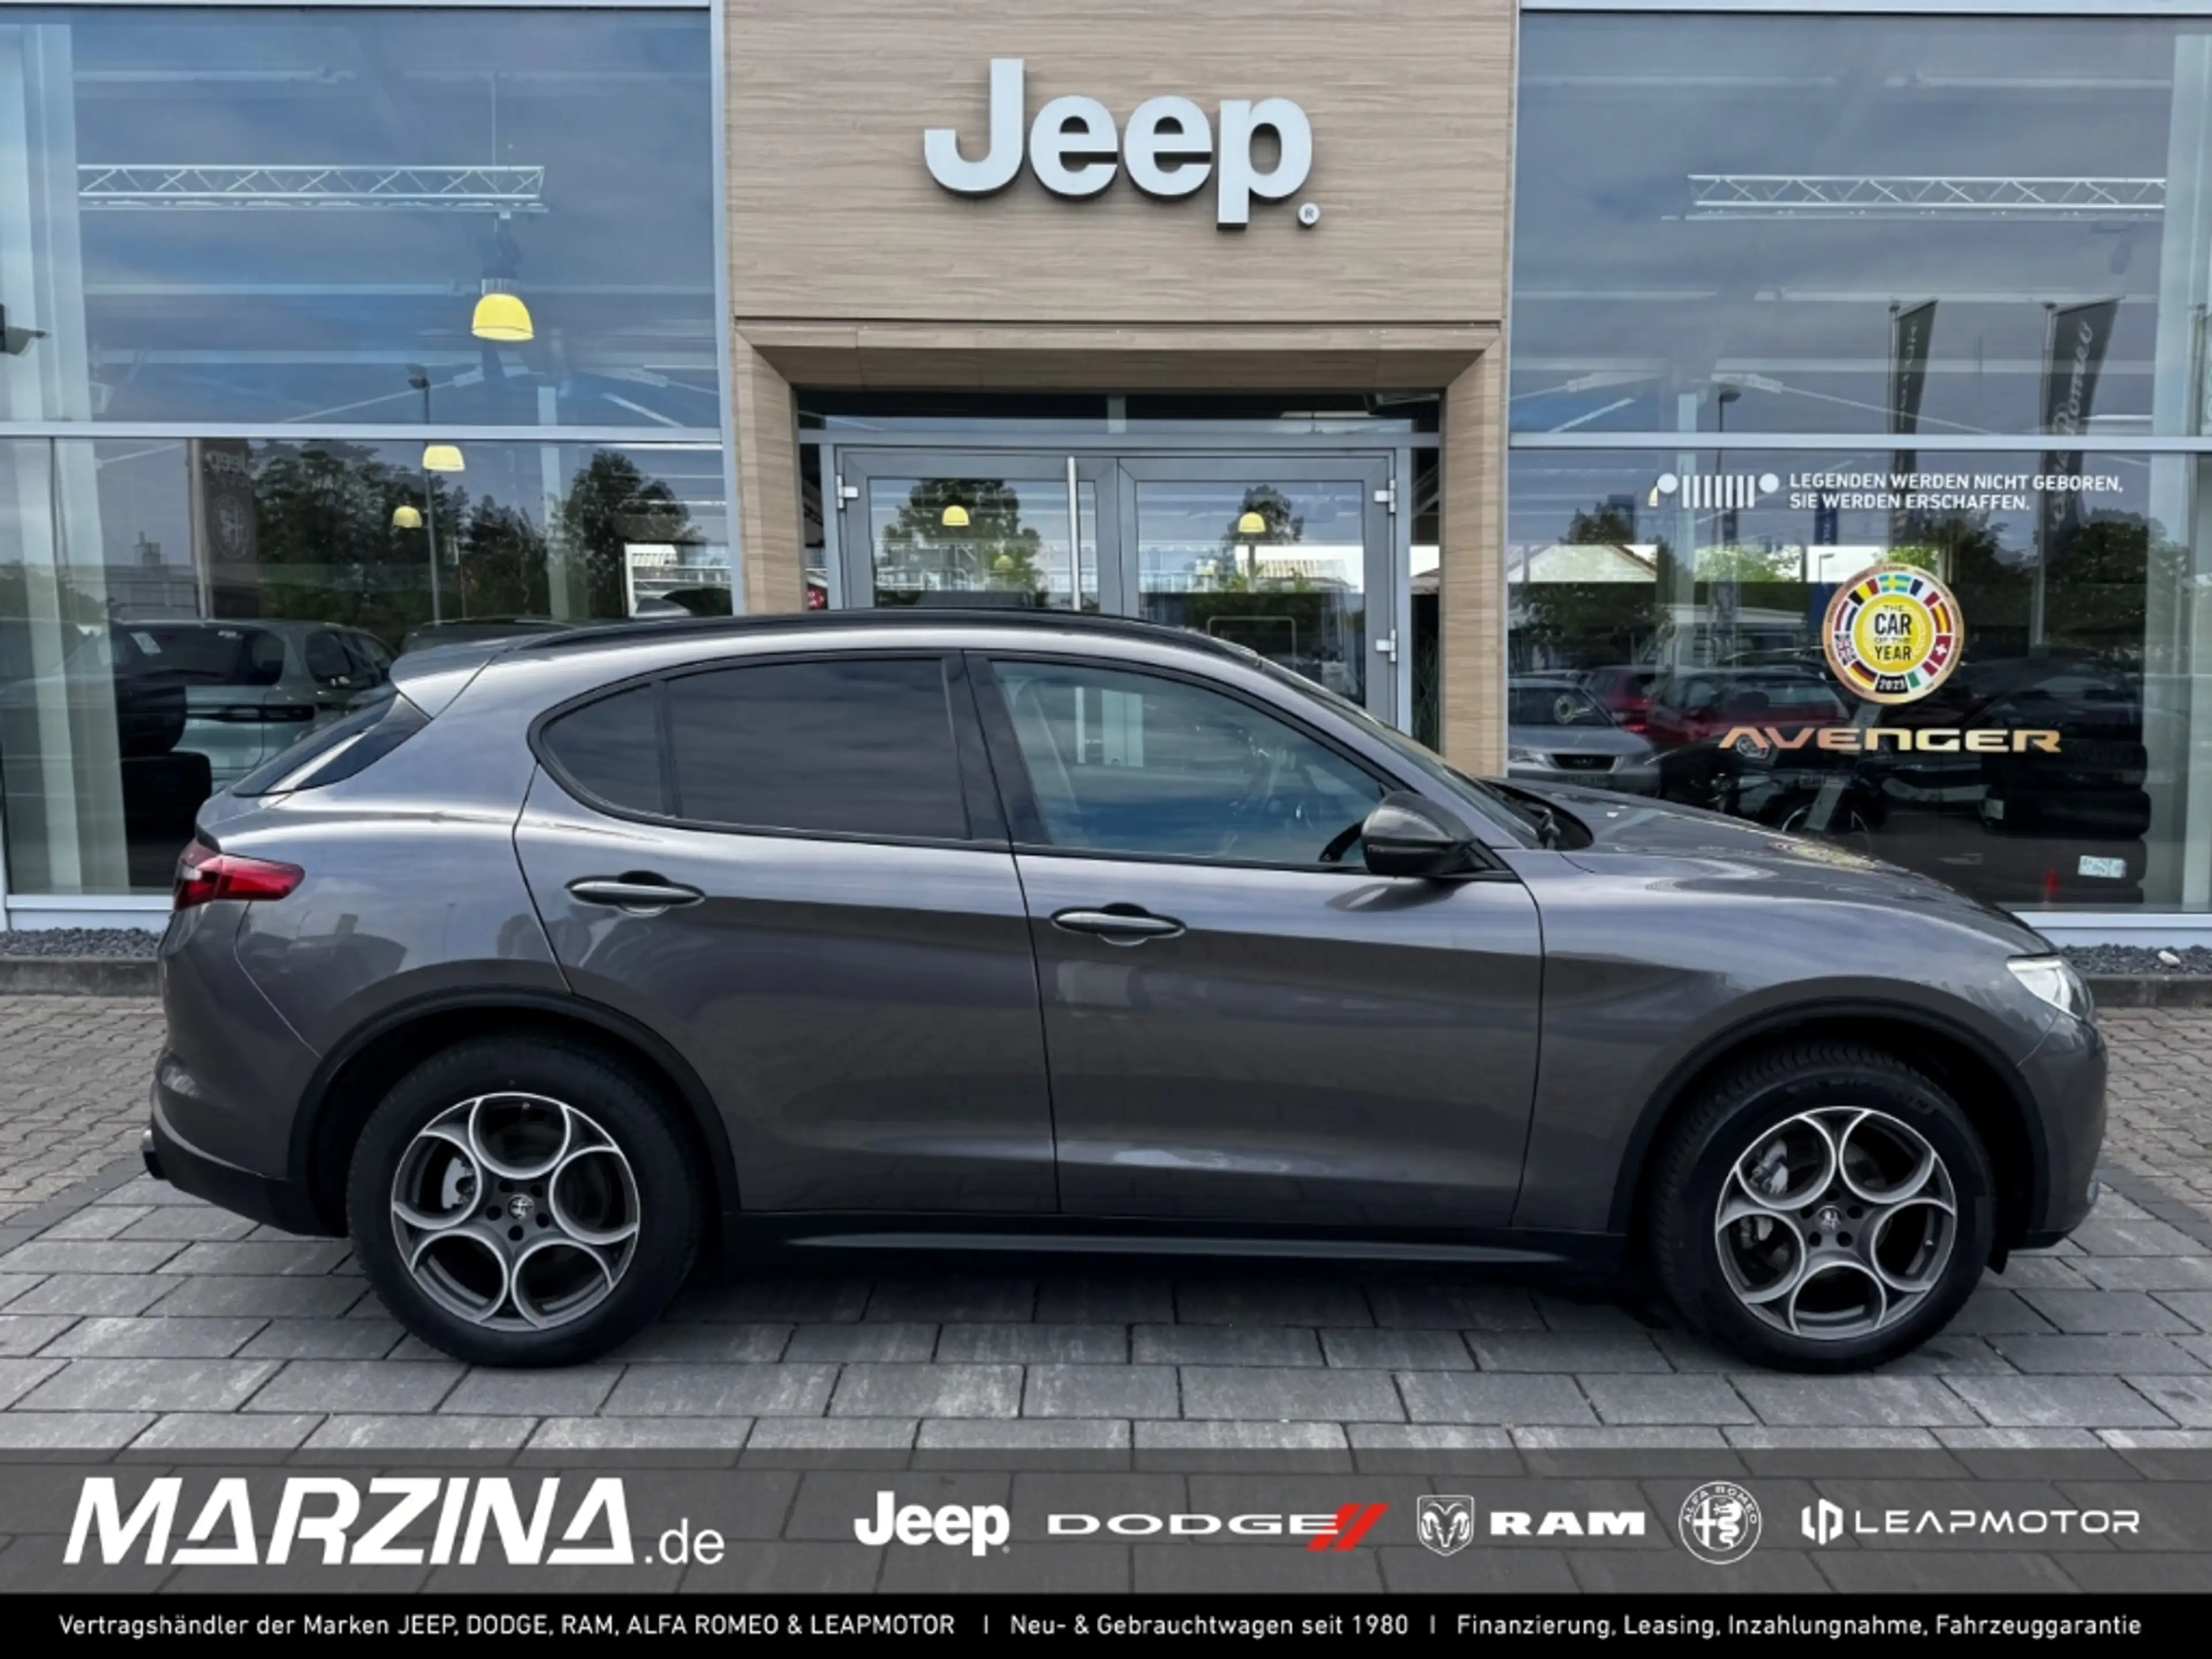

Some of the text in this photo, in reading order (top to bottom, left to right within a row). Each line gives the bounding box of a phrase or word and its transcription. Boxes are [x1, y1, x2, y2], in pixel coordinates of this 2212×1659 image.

[924, 59, 1312, 225] Jeep
[1789, 472, 2124, 493] LEGENDEN WERDEN NICHT GEBOREN,
[1789, 493, 2031, 510] SIE WERDEN ERSCHAFFEN.
[1874, 613, 1912, 635] CAR
[1874, 646, 1912, 661] YEAR
[1719, 726, 2062, 753] AVENGER
